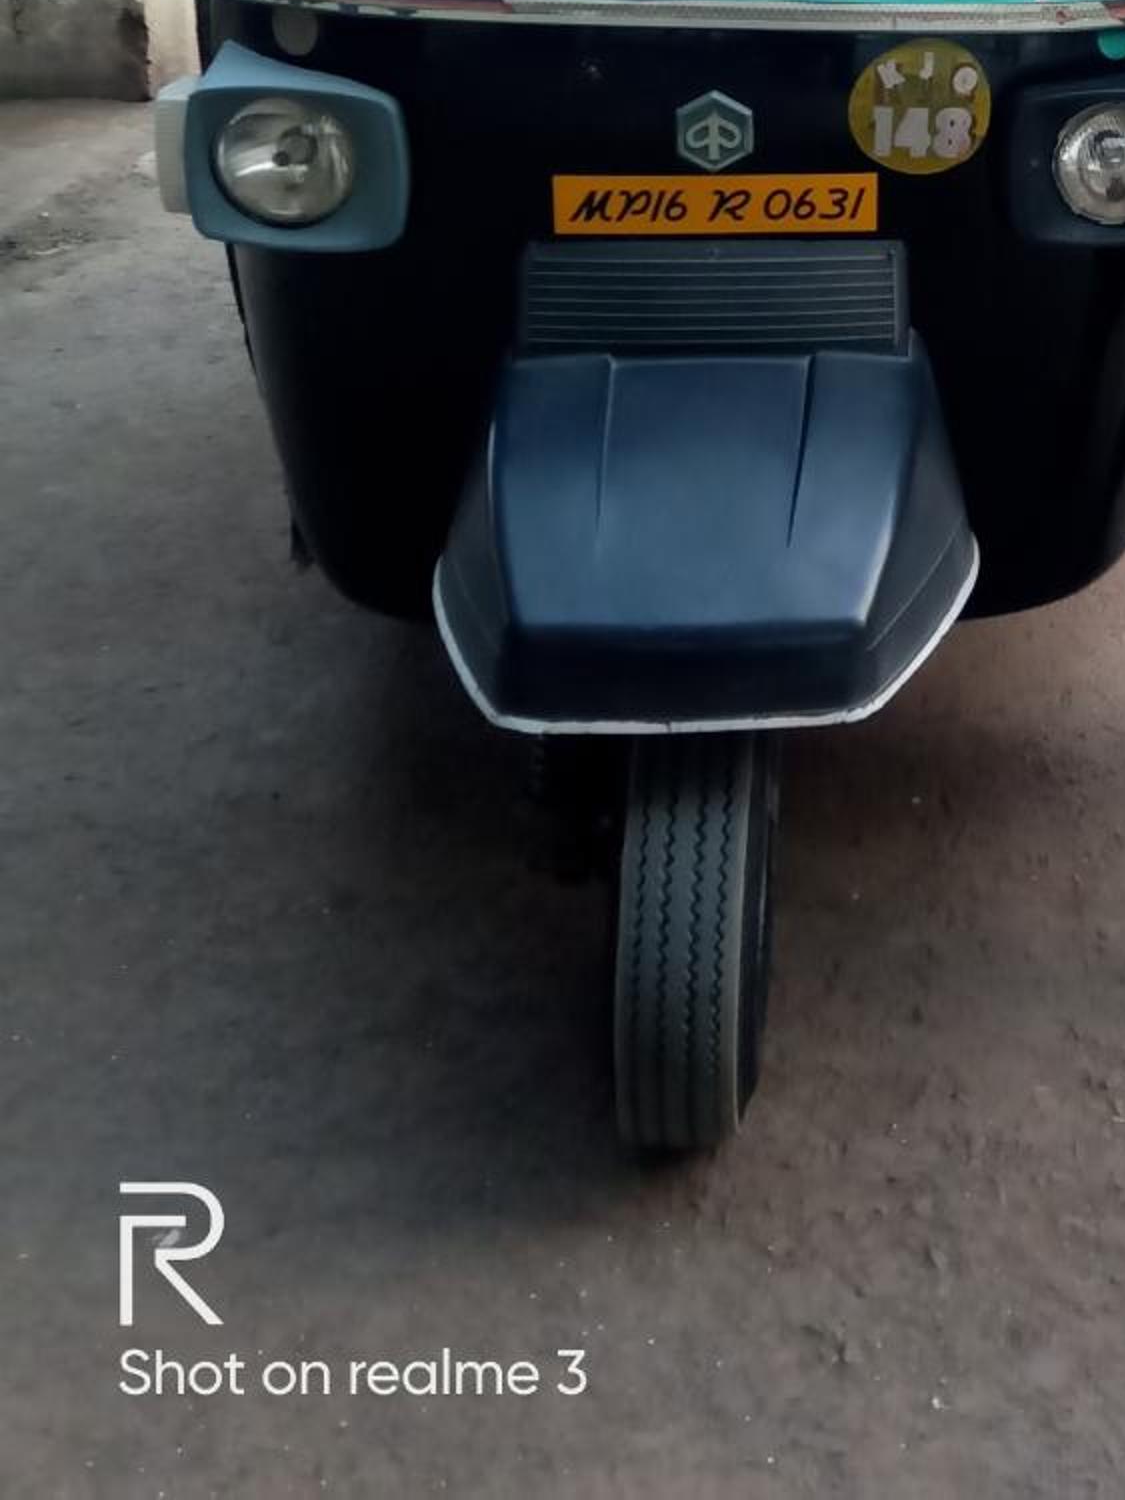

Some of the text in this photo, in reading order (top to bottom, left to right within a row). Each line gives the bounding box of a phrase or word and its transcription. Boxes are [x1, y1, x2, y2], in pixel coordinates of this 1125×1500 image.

[872, 105, 973, 159] 148
[568, 186, 867, 223] MP16 R 0631
